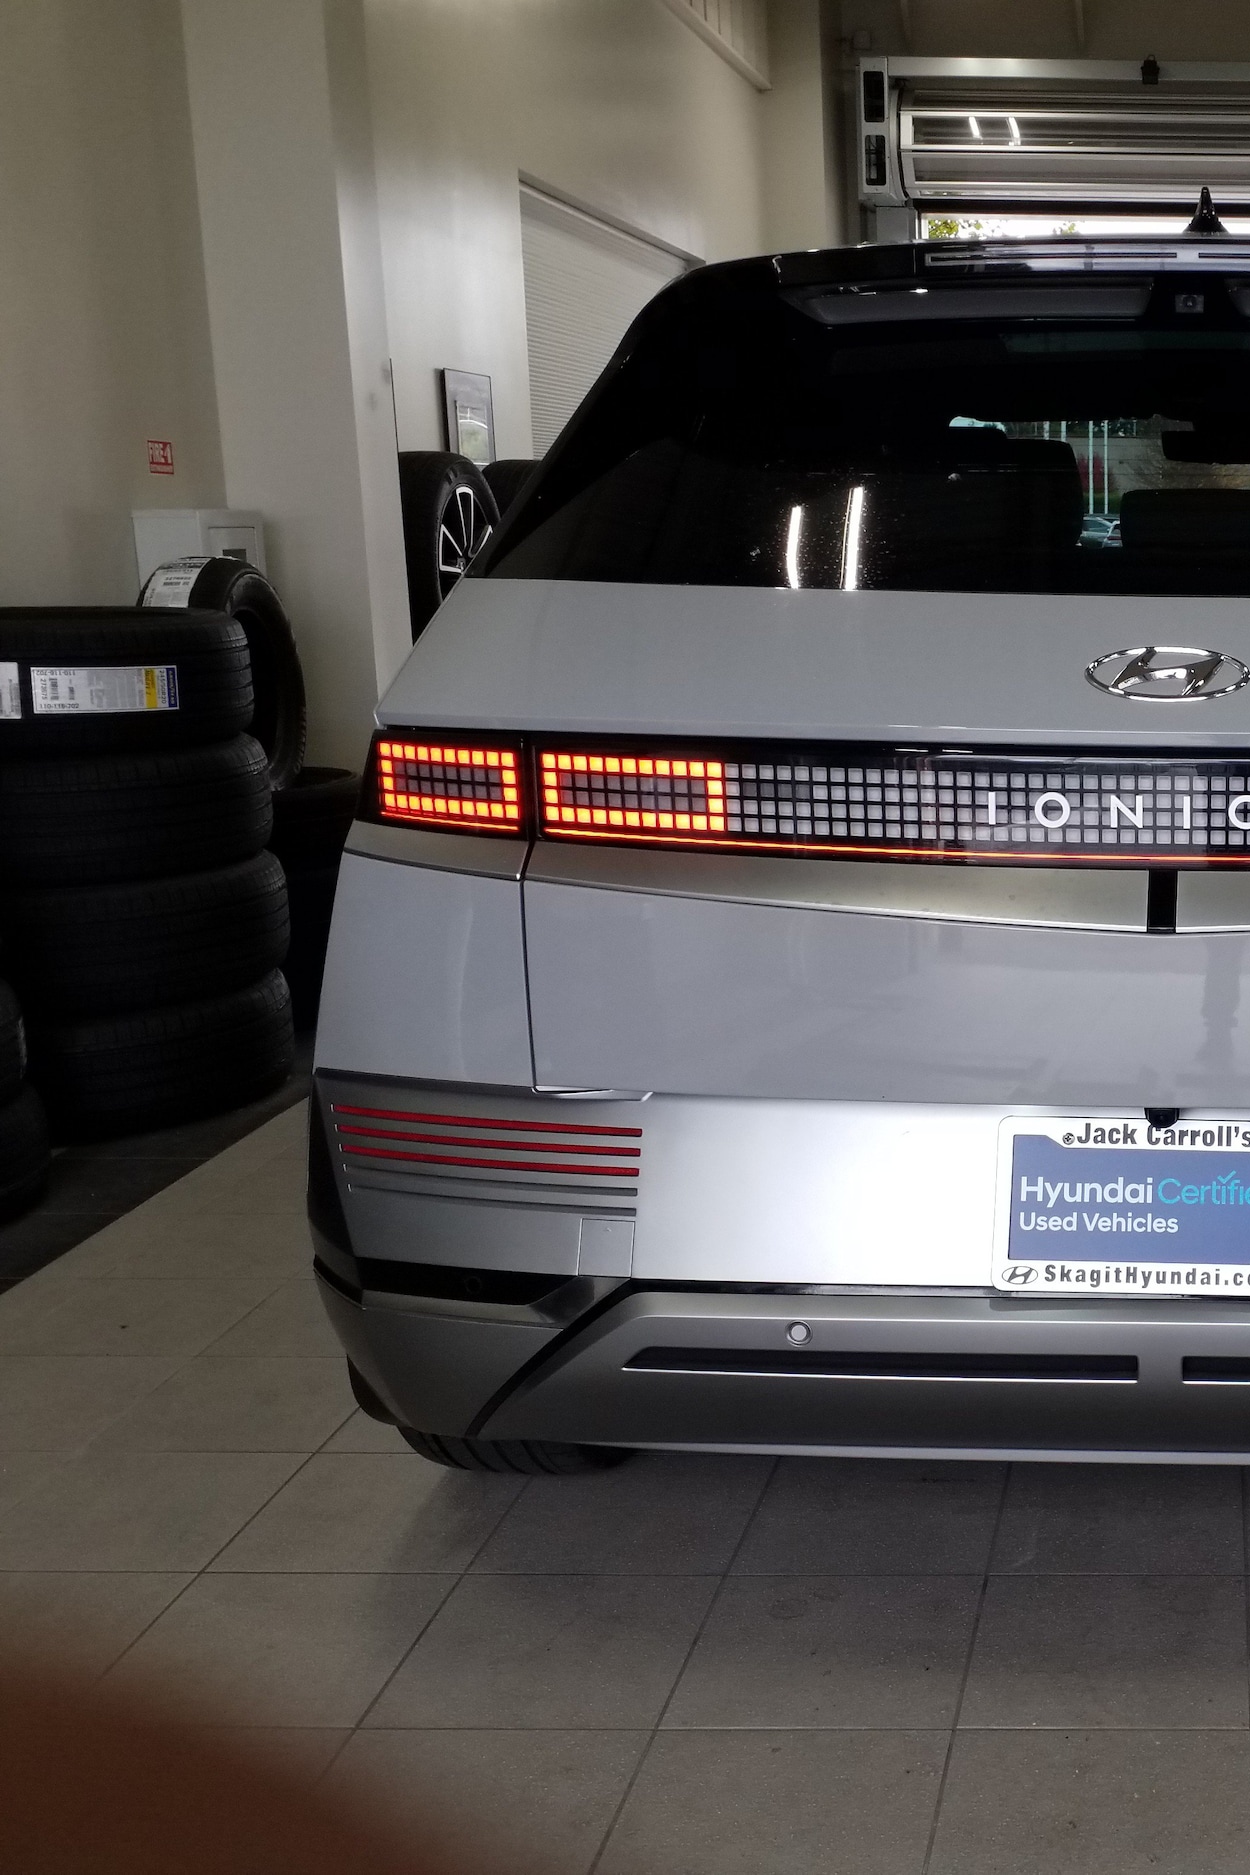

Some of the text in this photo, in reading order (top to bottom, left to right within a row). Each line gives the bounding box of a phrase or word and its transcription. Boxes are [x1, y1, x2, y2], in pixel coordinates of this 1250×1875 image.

[1076, 1122, 1138, 1146] Jack
[1020, 1176, 1154, 1208] Hyundai
[1019, 1212, 1179, 1233] Used Vehicles
